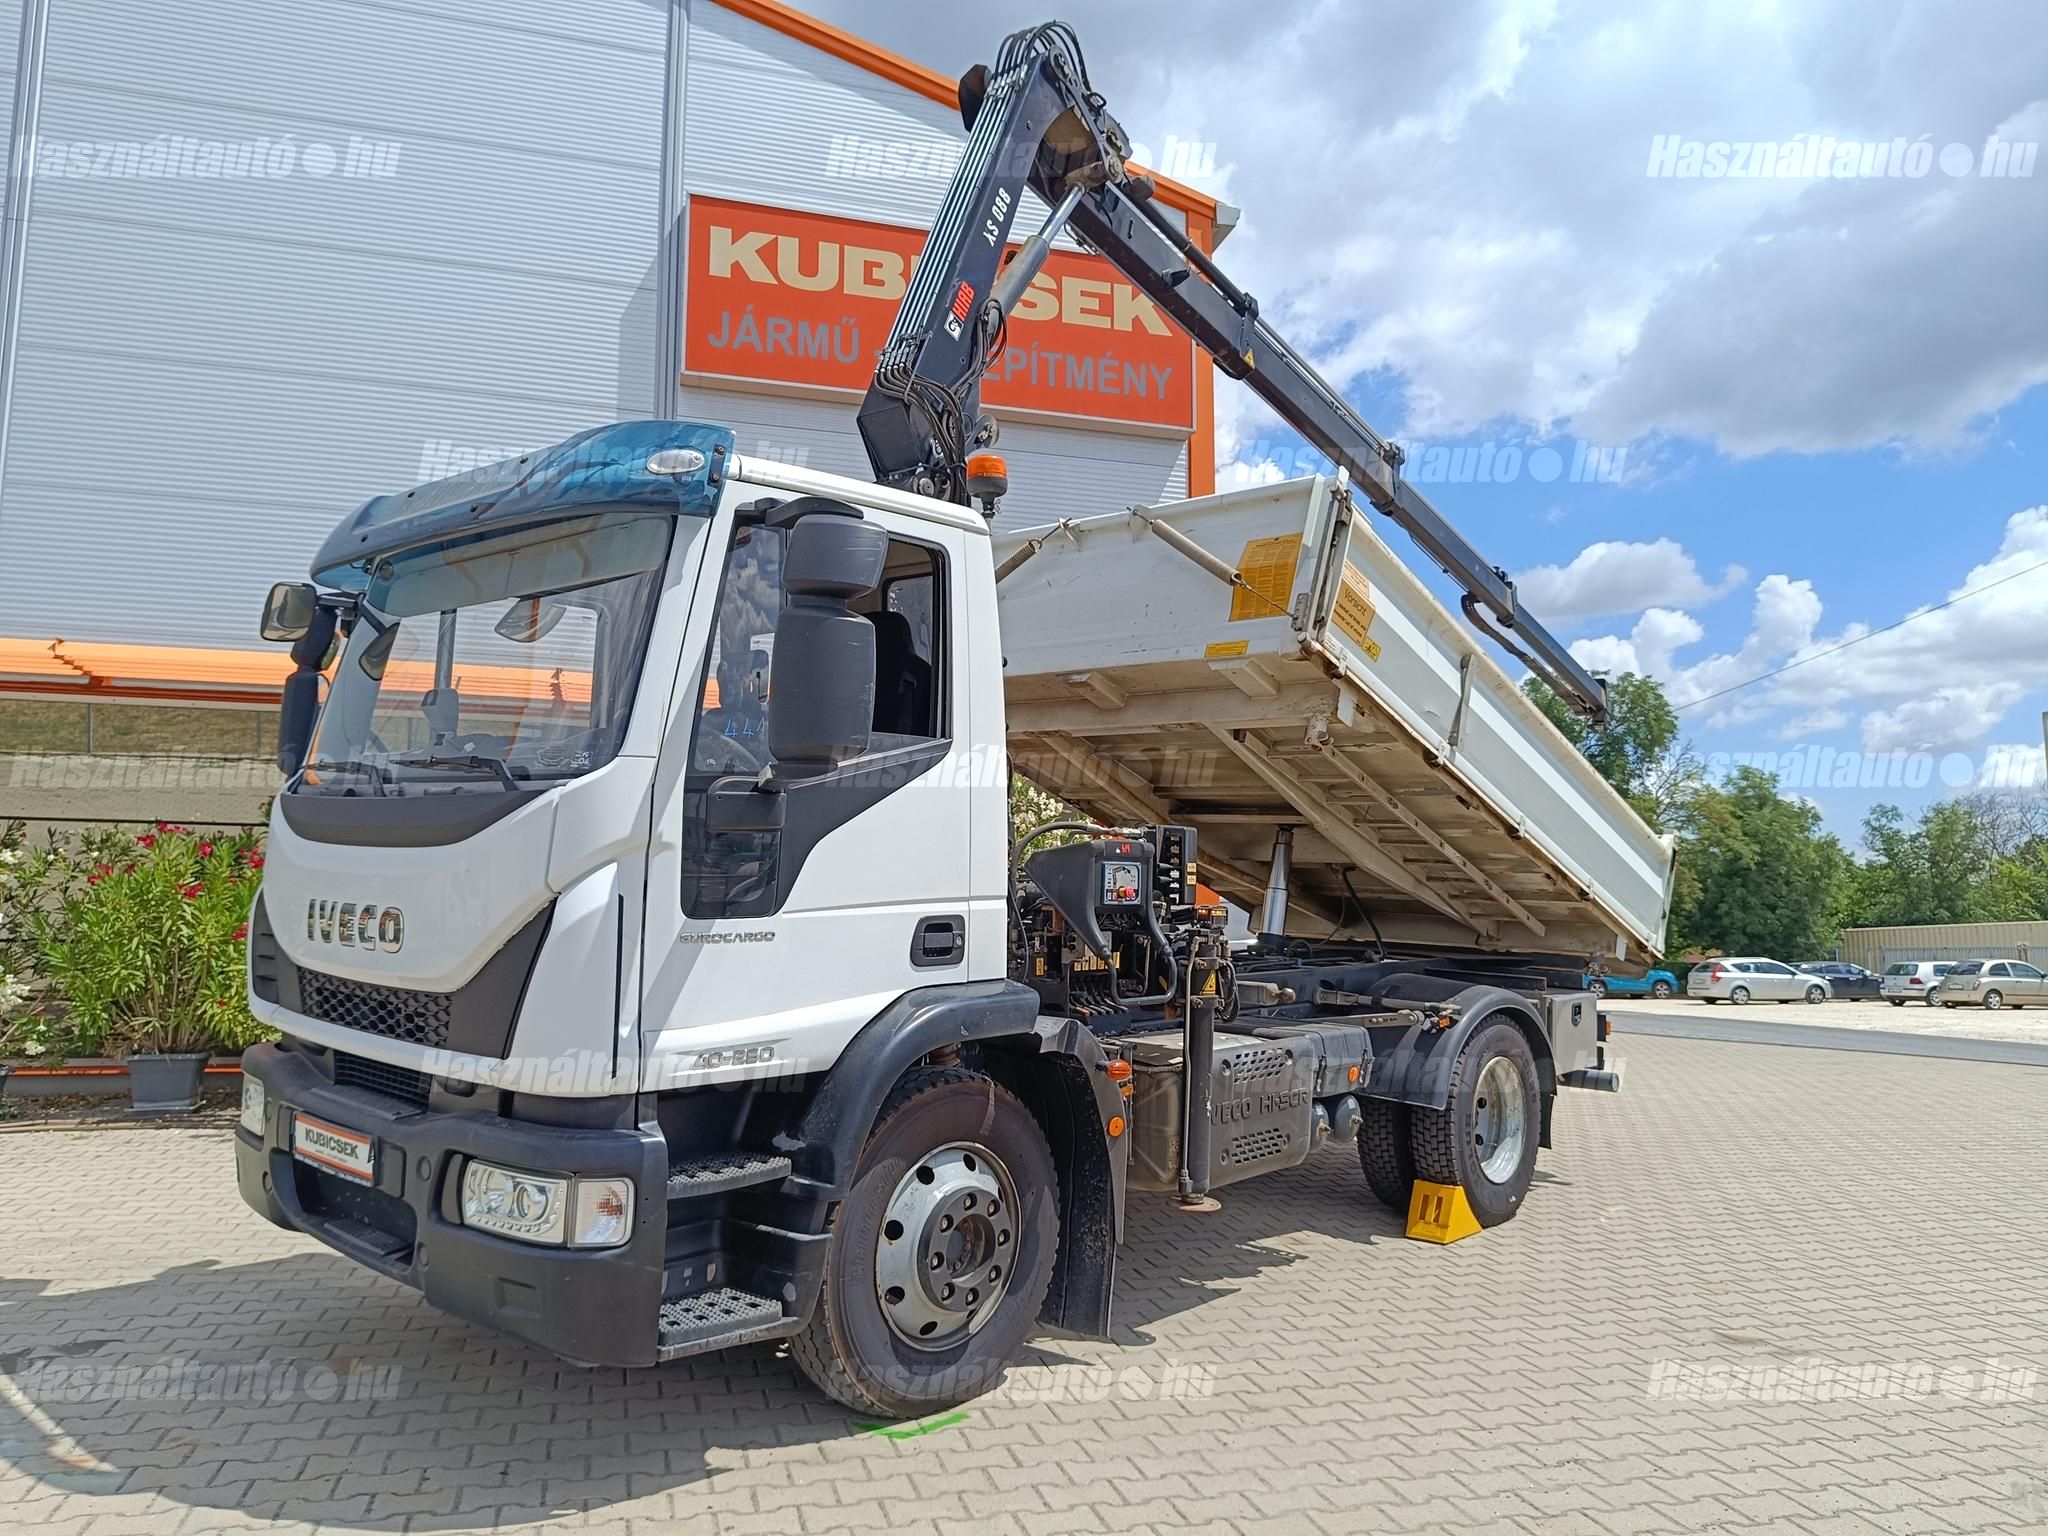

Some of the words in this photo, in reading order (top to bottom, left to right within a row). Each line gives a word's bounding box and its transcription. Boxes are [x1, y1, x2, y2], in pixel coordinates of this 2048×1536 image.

[709, 225, 1173, 337] KUBSEK
[952, 280, 976, 321] HIAB
[707, 303, 860, 364] JÁRMŰ
[1344, 588, 1367, 617] Vorsicht
[307, 899, 405, 954] IVECO
[680, 932, 776, 945] EUROCARGO
[1209, 1097, 1251, 1127] VECO
[305, 1127, 360, 1160] KUBICSEK
